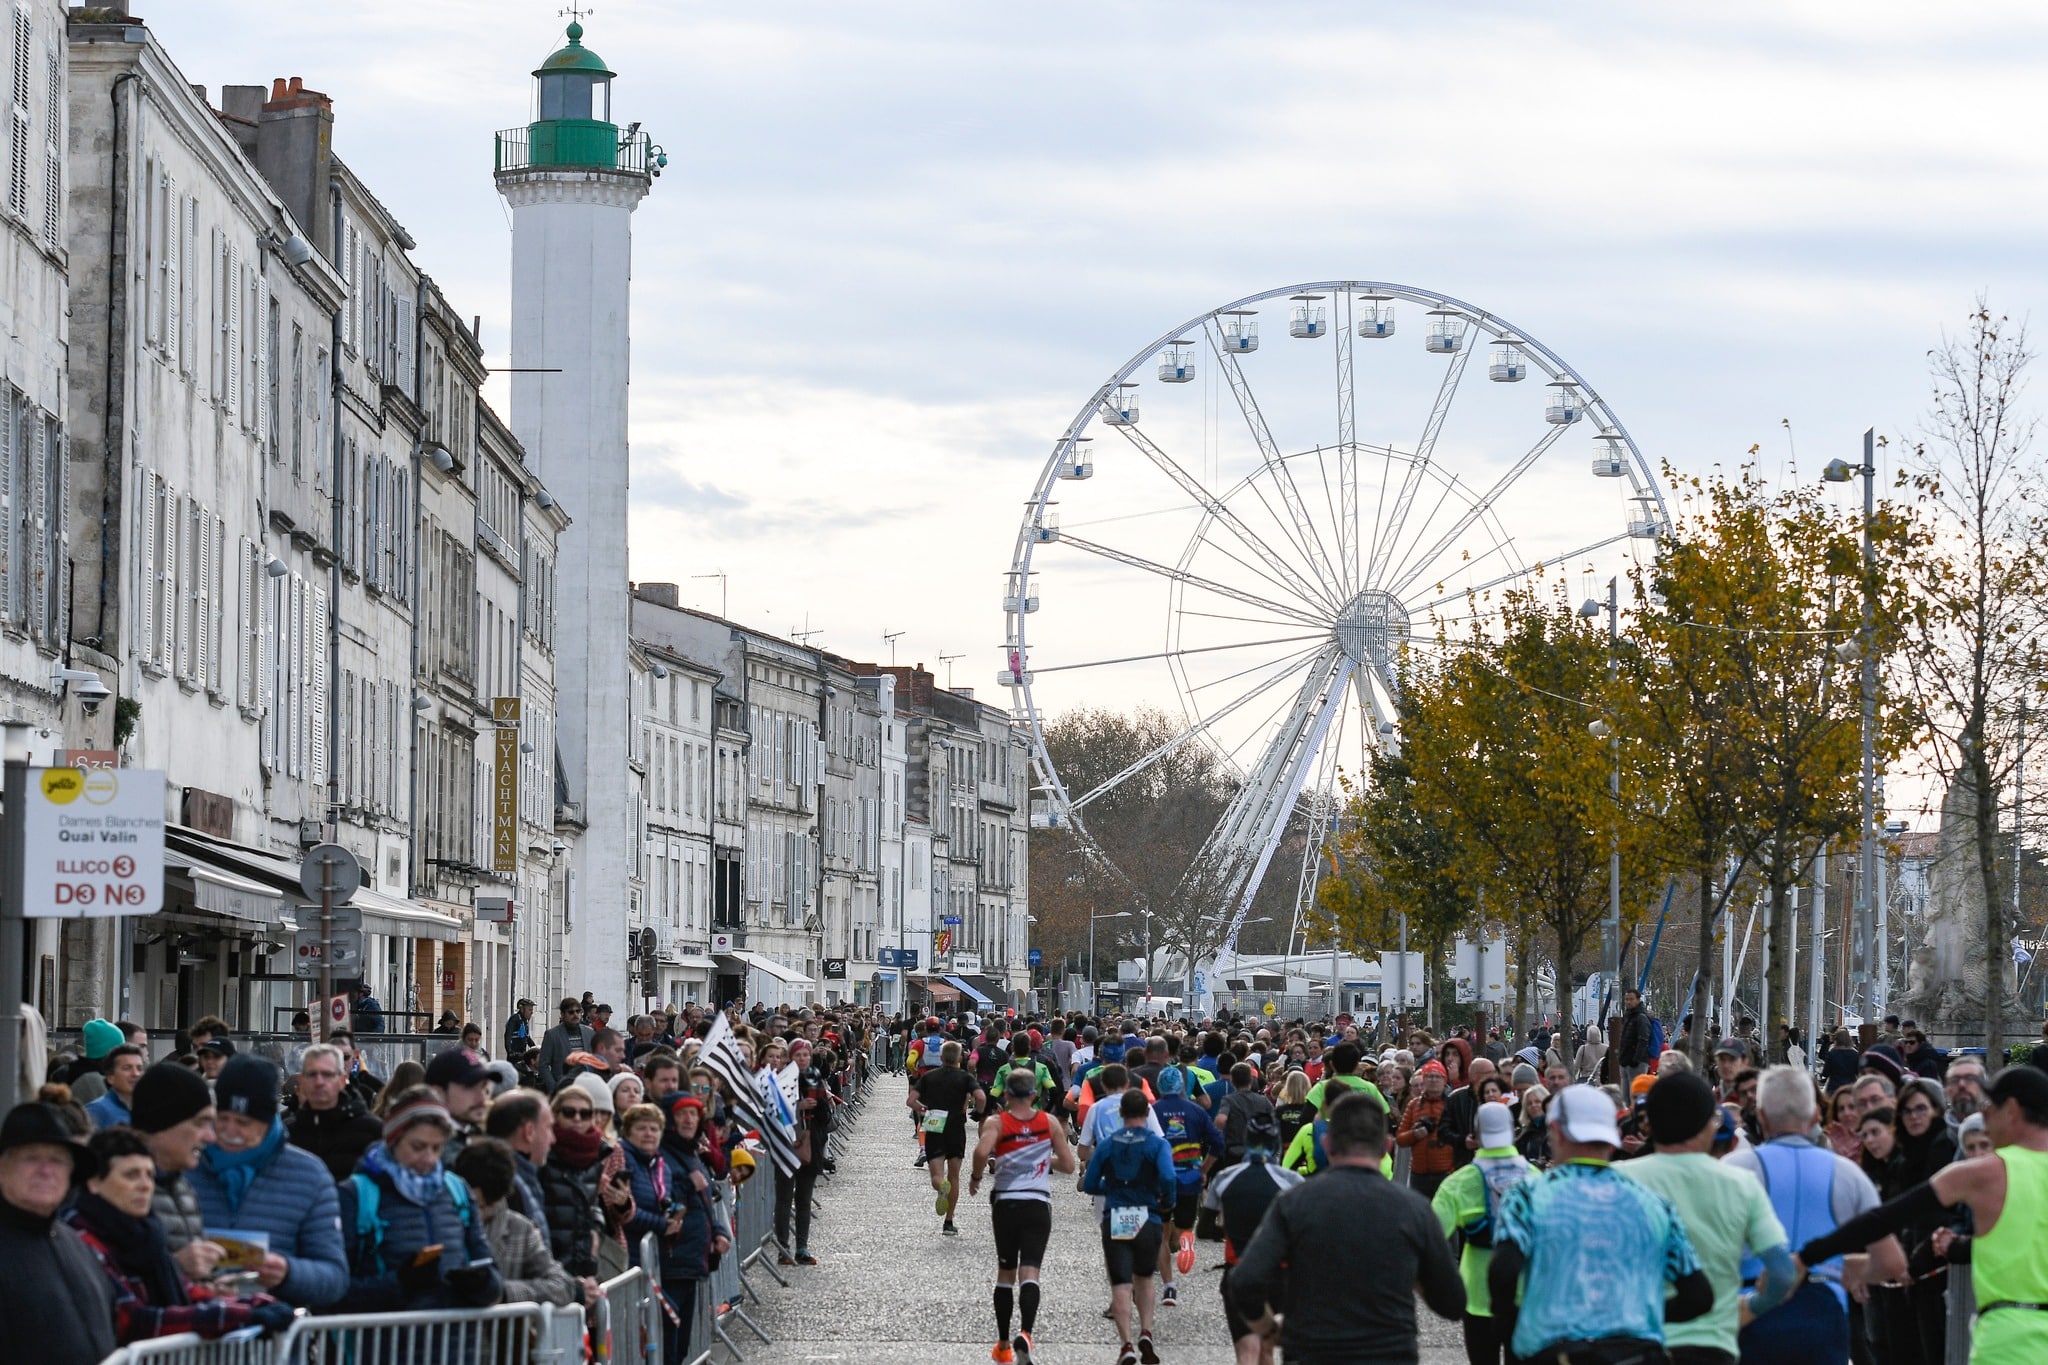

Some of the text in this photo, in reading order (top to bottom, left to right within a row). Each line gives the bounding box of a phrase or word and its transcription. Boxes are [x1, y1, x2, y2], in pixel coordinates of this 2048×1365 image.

[500, 730, 514, 741] LE
[498, 744, 513, 855] YACHTMAN
[58, 814, 162, 827] Dames Blanches
[58, 830, 138, 843] Quai Valin
[57, 860, 110, 874] ILLICO
